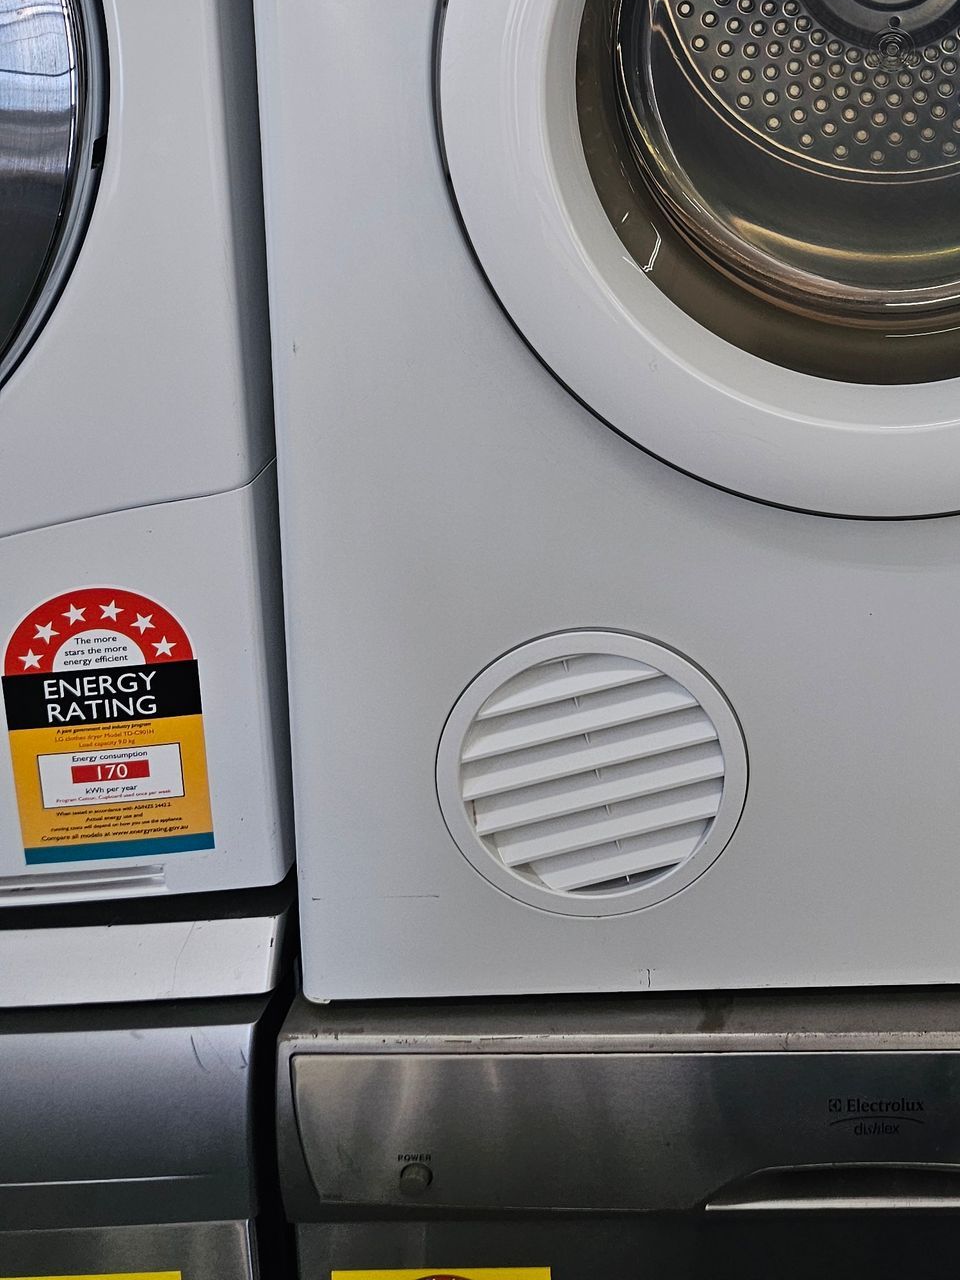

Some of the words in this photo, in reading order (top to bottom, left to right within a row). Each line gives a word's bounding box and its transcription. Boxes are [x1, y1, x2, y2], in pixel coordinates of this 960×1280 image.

[74, 637, 91, 645] The
[94, 636, 117, 644] more
[63, 658, 92, 666] energy
[95, 654, 128, 663] efficient
[43, 671, 156, 700] ENERGY
[47, 695, 157, 723] RATING
[100, 751, 148, 760] consumption
[97, 764, 128, 780] 170
[847, 1098, 924, 1112] Electrolux
[398, 1154, 431, 1162] POWER
